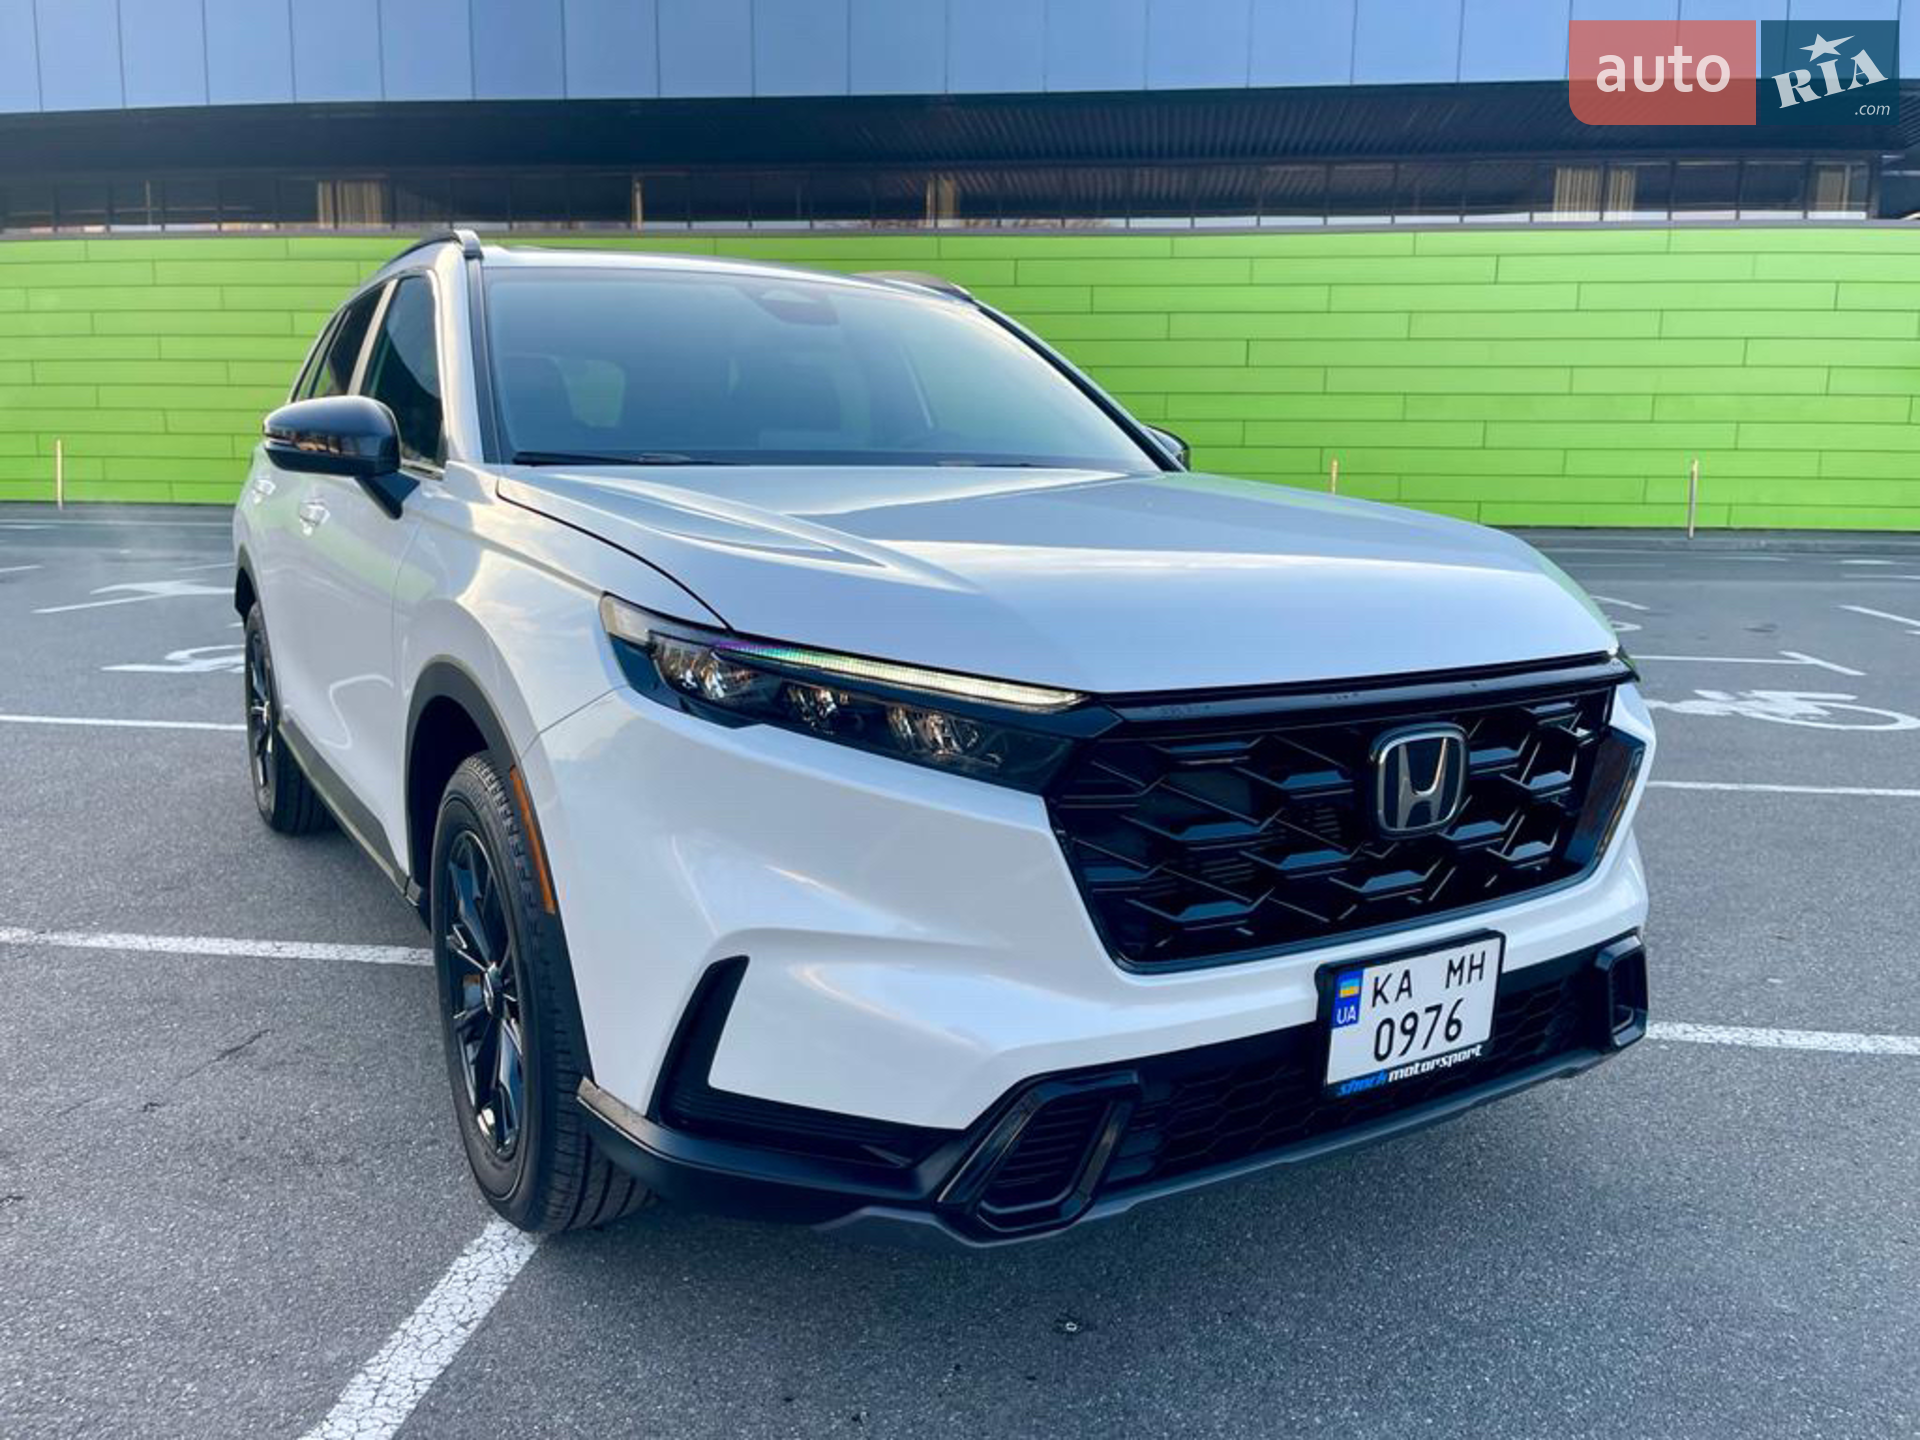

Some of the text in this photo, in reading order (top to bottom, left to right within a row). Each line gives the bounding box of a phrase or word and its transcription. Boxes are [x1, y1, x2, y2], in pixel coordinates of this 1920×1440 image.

[1371, 950, 1486, 1008] KA MH
[1335, 1005, 1357, 1025] UA
[1373, 997, 1465, 1062] 0976
[1388, 1044, 1482, 1083] motorsport
